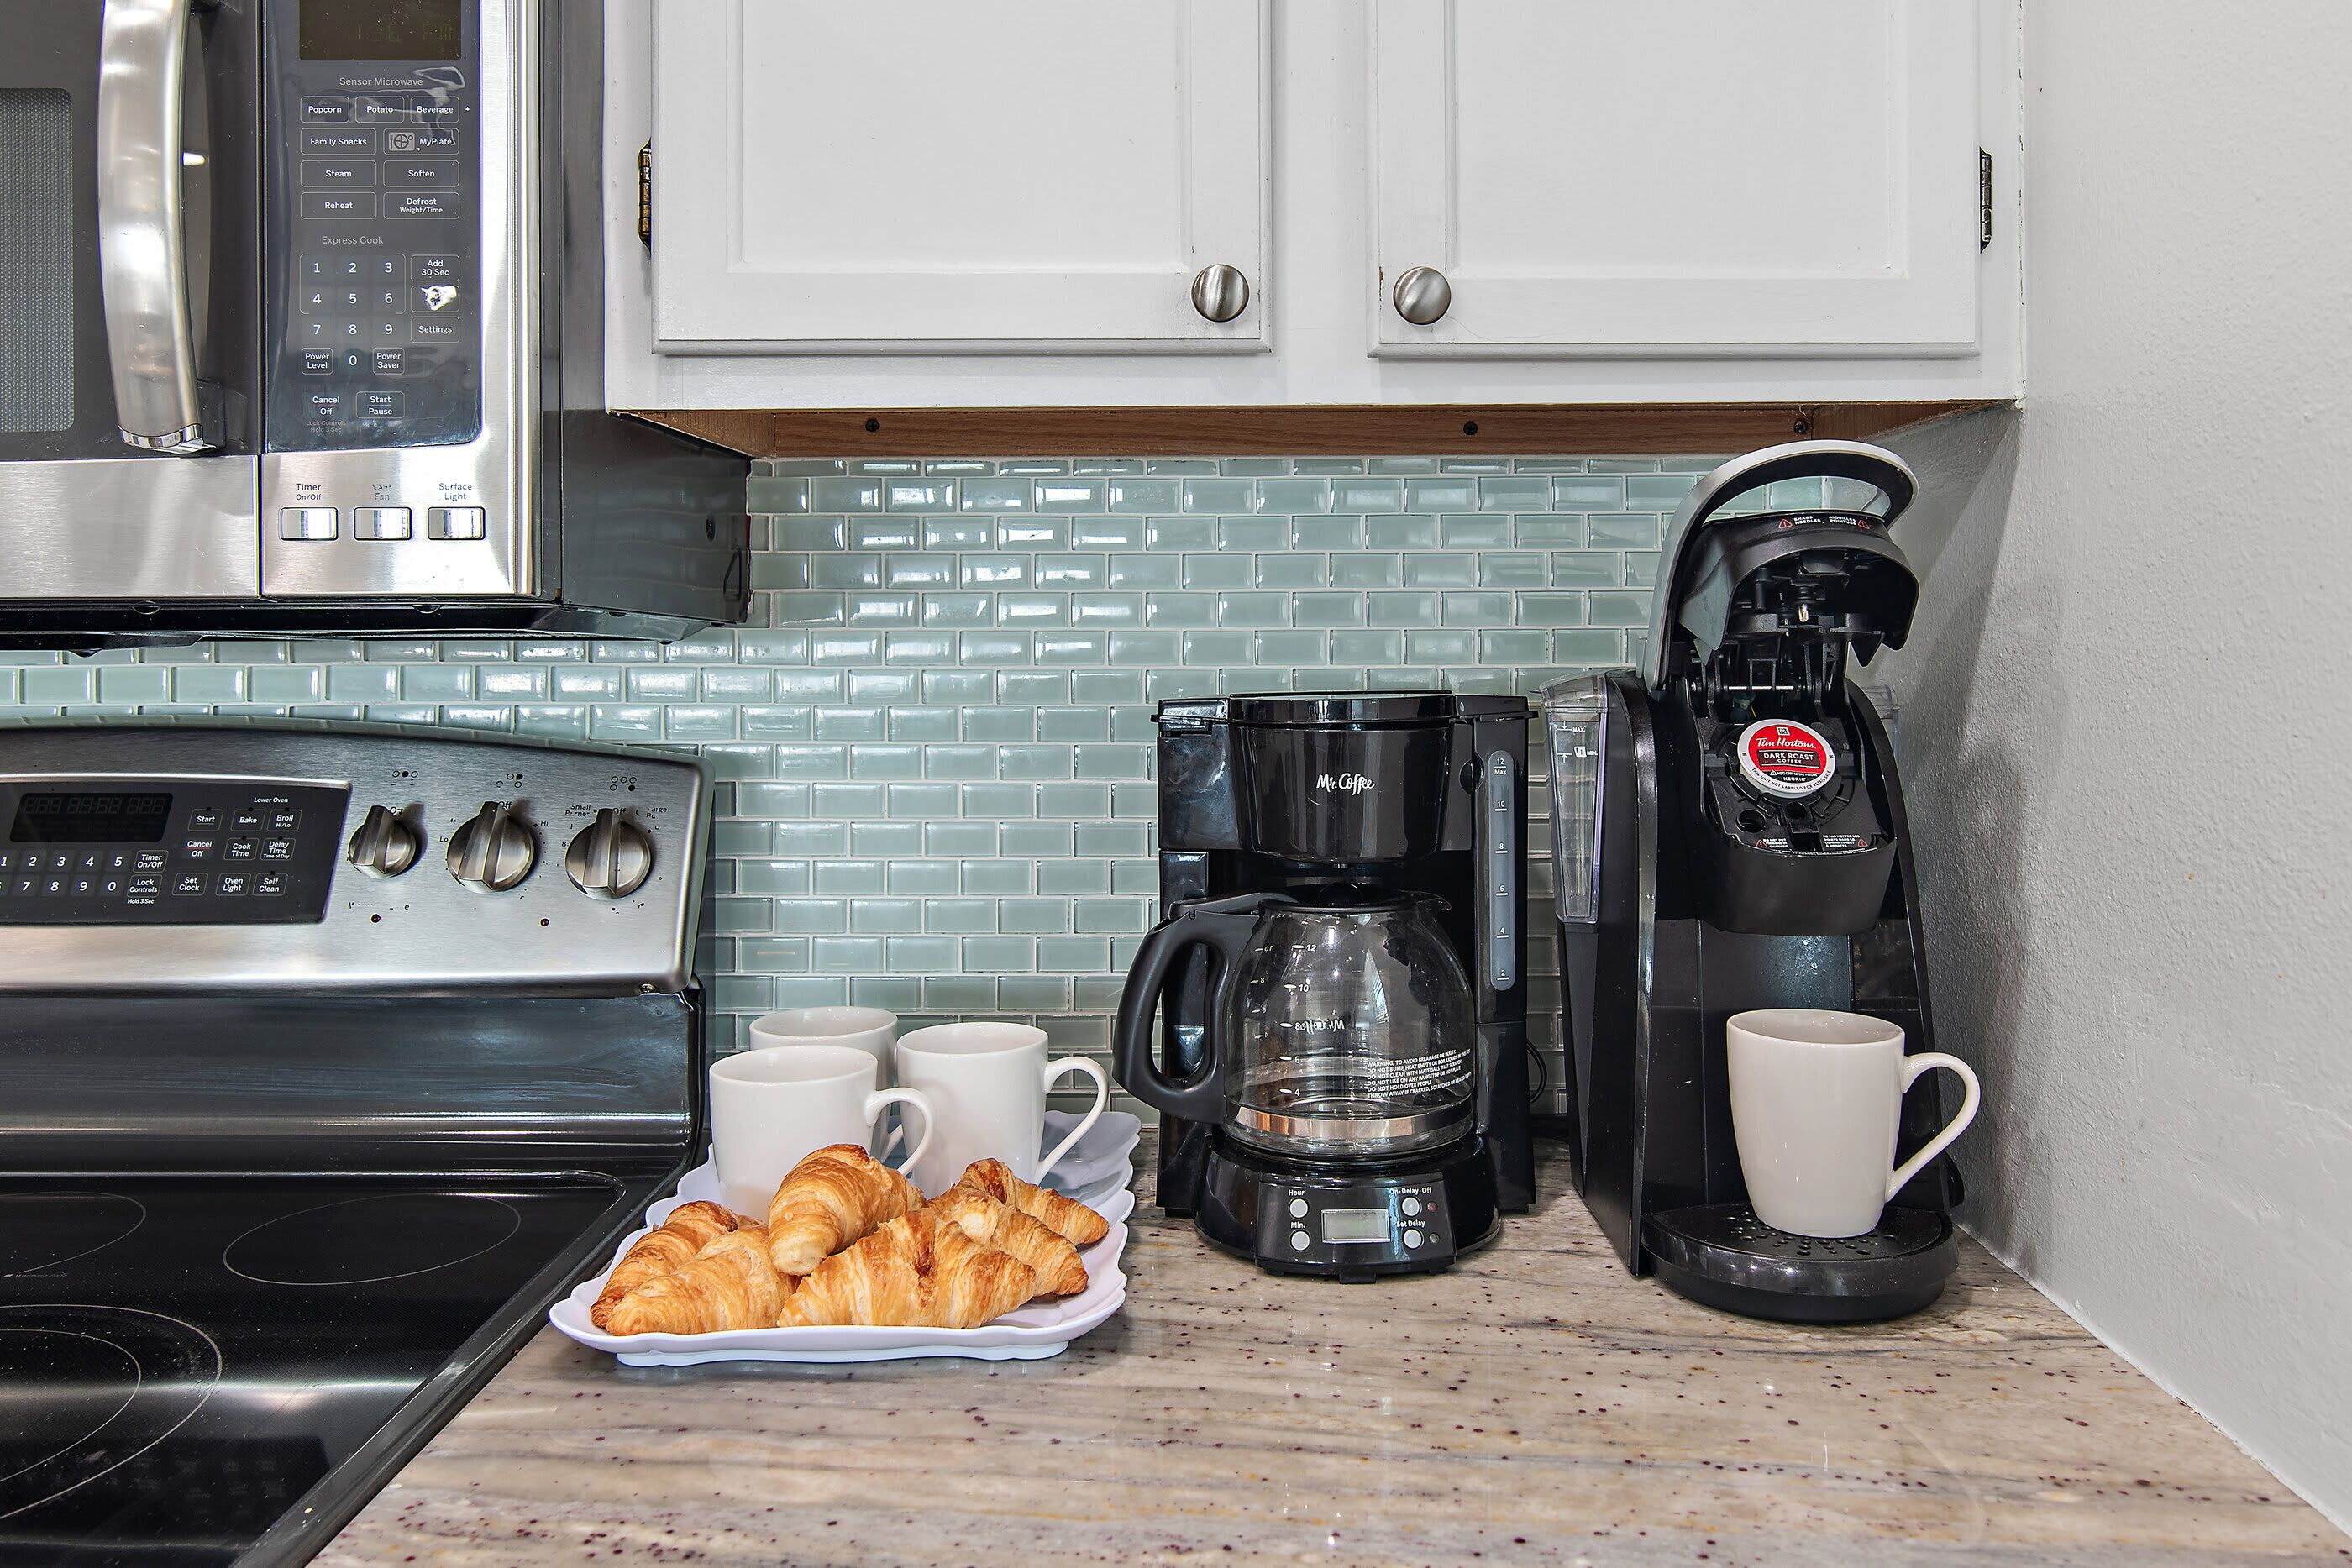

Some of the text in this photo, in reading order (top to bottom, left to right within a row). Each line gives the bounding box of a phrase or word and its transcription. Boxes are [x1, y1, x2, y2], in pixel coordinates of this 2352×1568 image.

[339, 77, 423, 86] Sensor Microwave
[308, 106, 342, 115] Popcorn
[417, 106, 454, 115] Beverage
[310, 139, 336, 147] Family
[419, 139, 453, 147] MyPlate
[407, 197, 437, 206] Defrost
[322, 236, 384, 245] Express Cook
[313, 263, 392, 273] 1 2 3
[312, 294, 392, 303] 4 5 6
[313, 325, 392, 334] 7 8 9
[418, 325, 453, 335] Settings
[349, 356, 357, 365] 0
[312, 396, 340, 404] Cancel
[319, 407, 333, 416] Off
[368, 407, 393, 416] Pause
[296, 493, 322, 501] On/Off
[444, 492, 467, 501] Light
[1756, 737, 1775, 747] Tim
[1788, 753, 1814, 761] ROAST
[1316, 772, 1375, 795] Mr. Coffee
[498, 800, 512, 809] Off
[269, 841, 290, 849] Delay
[1, 857, 123, 866] 1 2 3 4 5
[23, 882, 117, 891] 7 8 9 0
[1294, 1022, 1300, 1030] 8
[1294, 1056, 1299, 1064] 6
[1417, 1079, 1432, 1088] PEOPLE
[1294, 1088, 1300, 1097] 4
[1408, 1219, 1425, 1229] Delay
